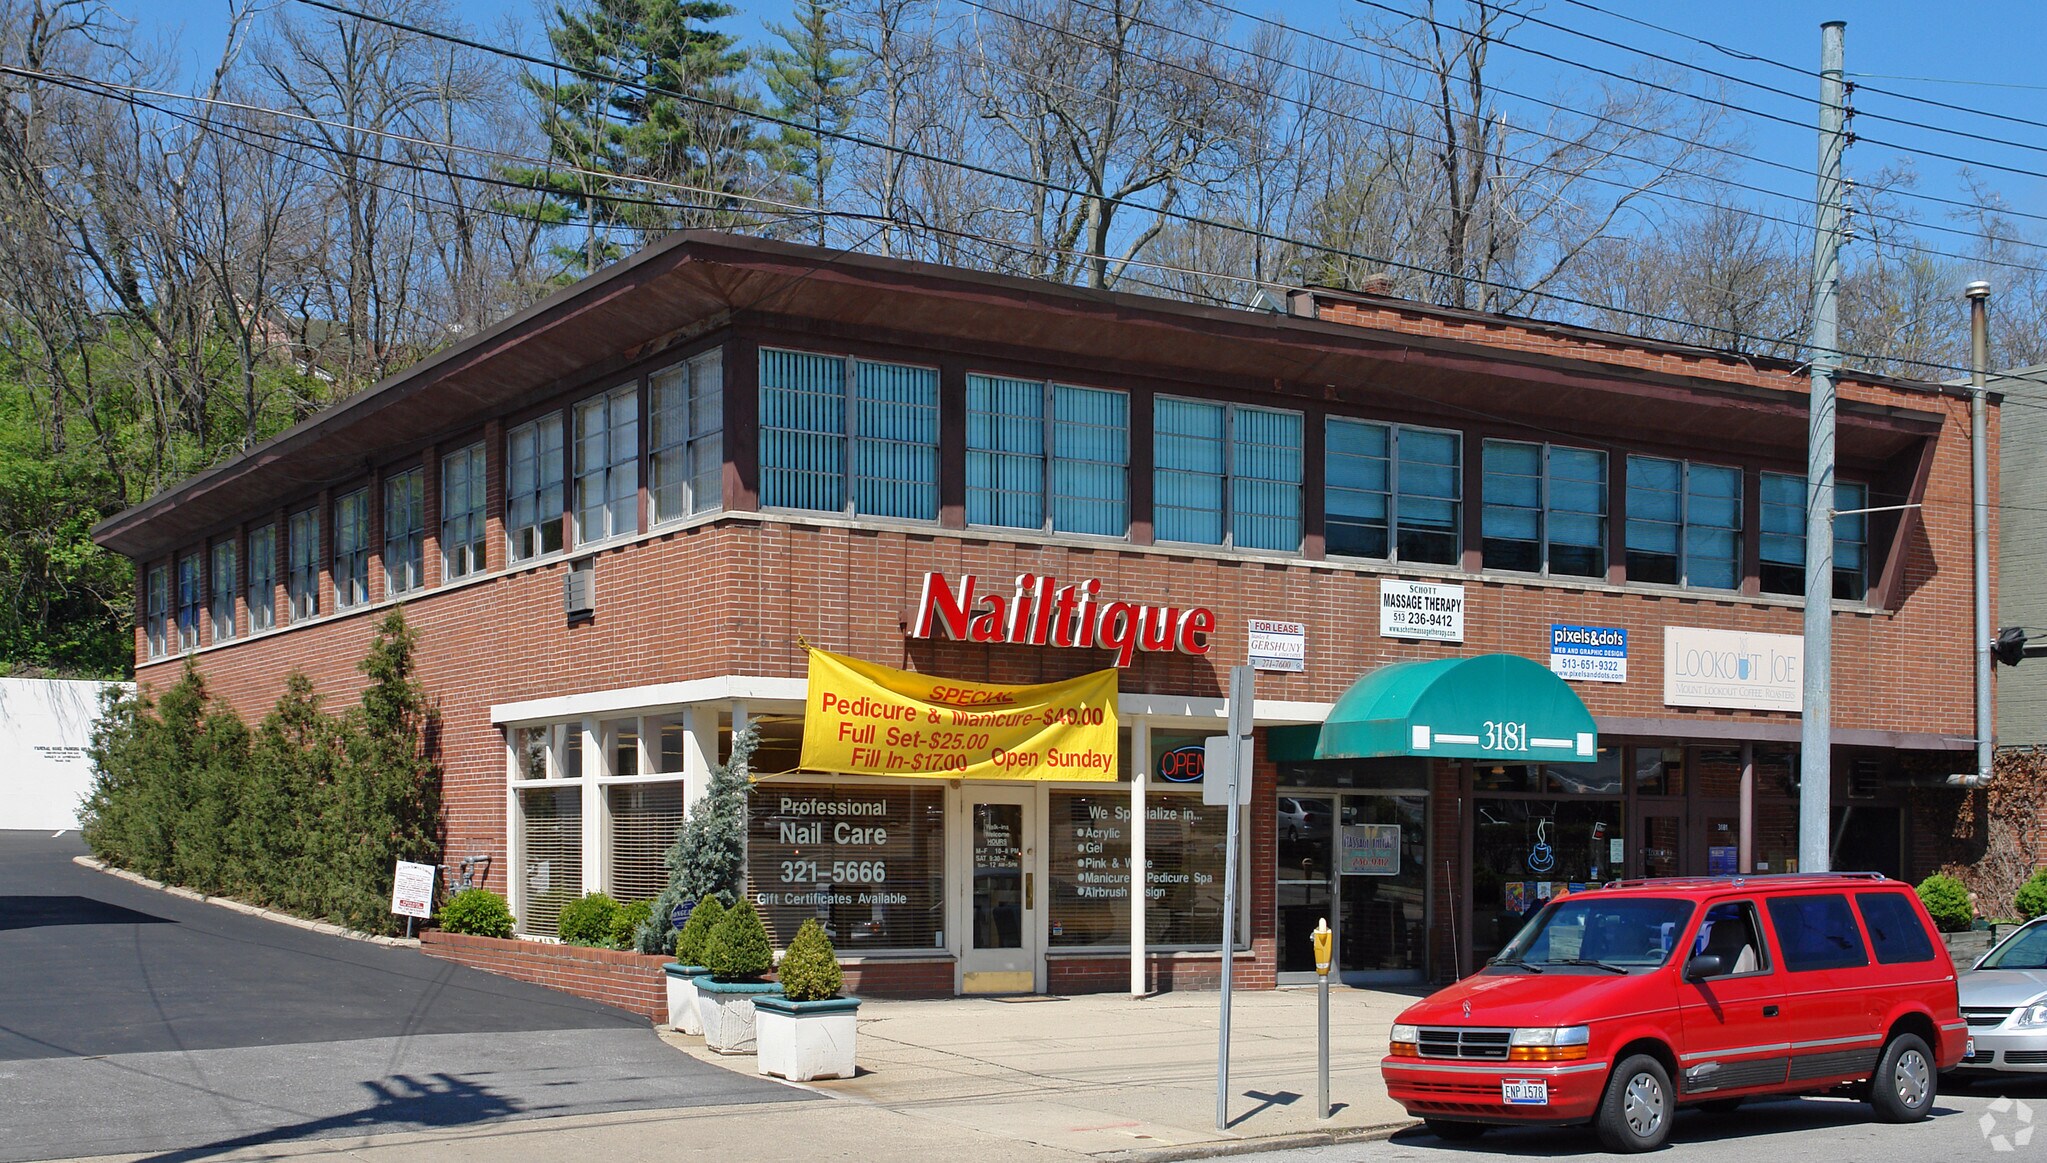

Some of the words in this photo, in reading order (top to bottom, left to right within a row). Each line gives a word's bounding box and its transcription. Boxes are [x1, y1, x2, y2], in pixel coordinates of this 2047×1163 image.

[1409, 585, 1437, 595] SCHOTT
[1383, 593, 1422, 610] MASSAGE
[1424, 596, 1461, 613] THERAPY
[912, 571, 1217, 668] Nailtique
[1393, 612, 1406, 621] 513
[1408, 612, 1453, 627] 236-9412
[1254, 621, 1271, 632] FOR
[1272, 623, 1299, 634] LEASE
[1554, 626, 1624, 646] pixels&dots
[1251, 640, 1303, 653] GERSHUNY
[1580, 648, 1604, 656] GRAPHIC
[1562, 659, 1618, 672] 513-651-9322
[822, 692, 917, 722] Pedicure
[927, 707, 941, 725] &
[838, 721, 876, 744] Full
[885, 726, 989, 751] Set-$25.00
[1481, 720, 1529, 752] 3181
[851, 747, 881, 768] Fill
[991, 747, 1039, 771] Open
[1047, 747, 1113, 773] Sunday
[780, 797, 887, 816] Professional
[1088, 806, 1108, 820] We
[1115, 807, 1177, 823] Spialize
[779, 822, 822, 844] Nail
[833, 822, 887, 845] Care
[1085, 827, 1121, 842] Acrylic
[1085, 843, 1103, 854] Gel
[1085, 857, 1107, 869] Pink
[1111, 858, 1120, 868] &
[780, 860, 886, 883] 321-5666
[1084, 872, 1131, 883] Manicure
[1146, 873, 1190, 884] Pedicure
[1193, 872, 1213, 886] Spa
[757, 893, 779, 905] Gift
[784, 893, 852, 905] Certificates
[858, 893, 907, 905] Available
[1084, 886, 1127, 898] Airbrush
[1505, 1085, 1521, 1098] ENP
